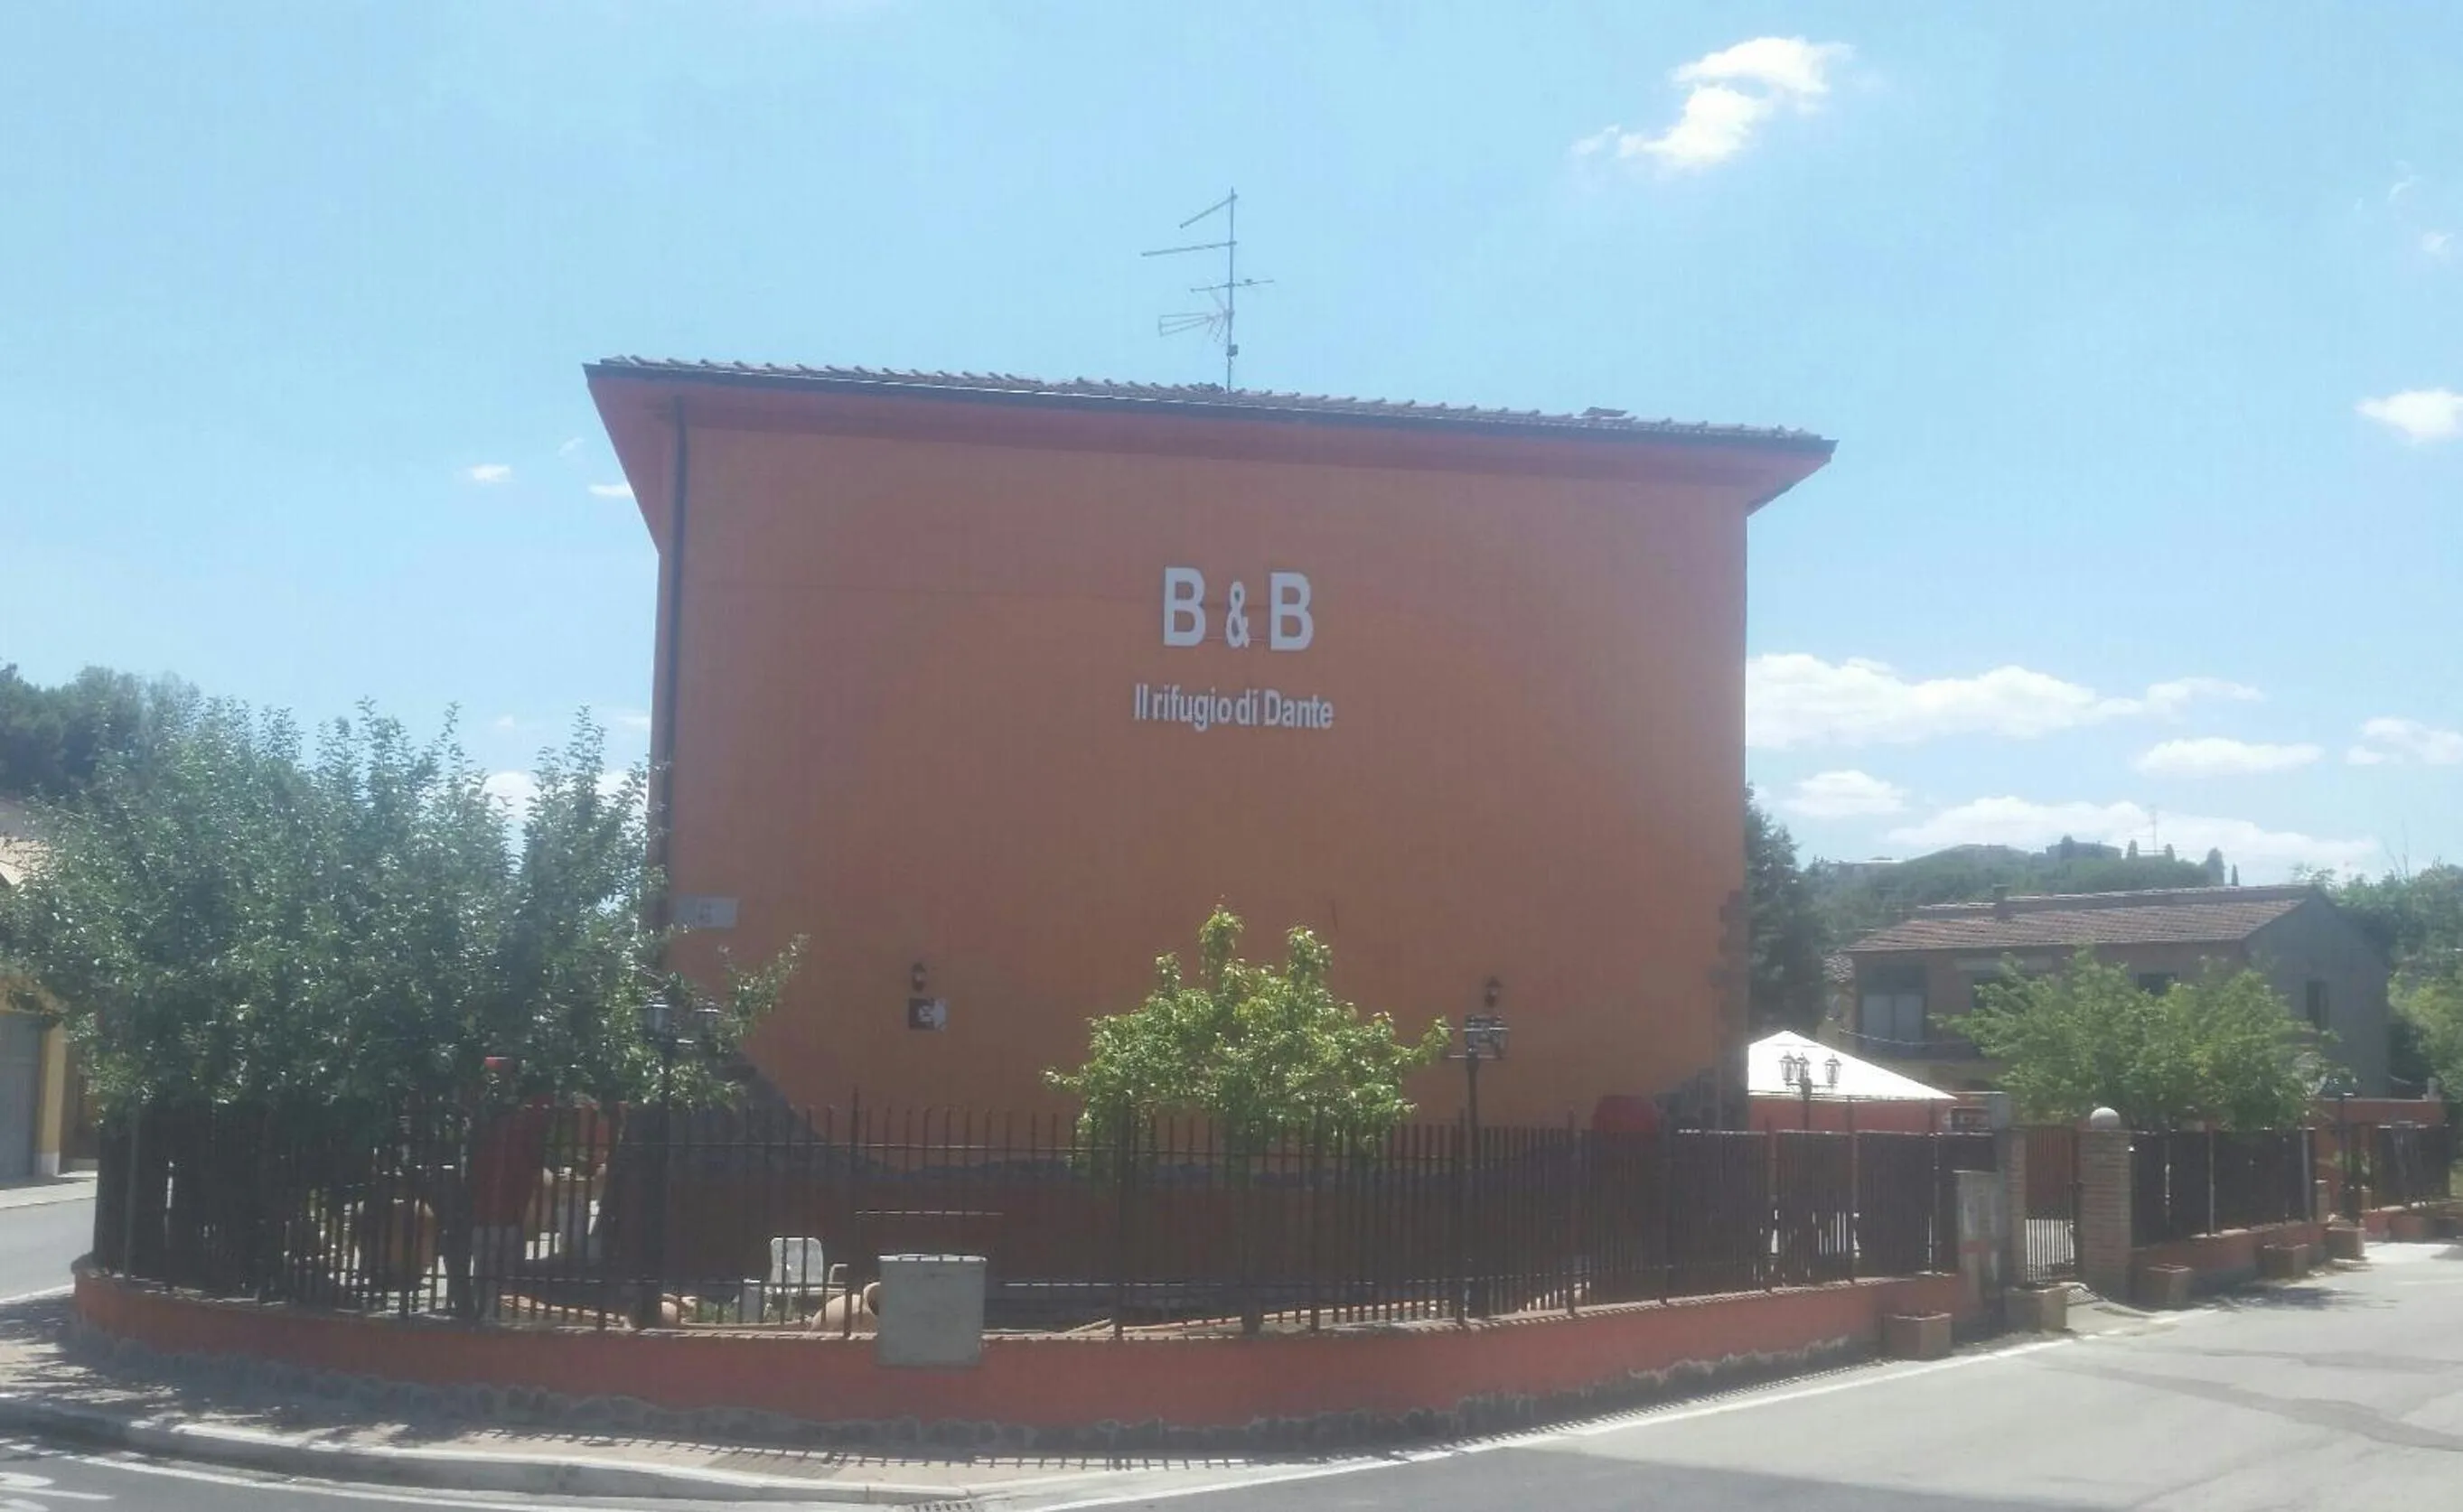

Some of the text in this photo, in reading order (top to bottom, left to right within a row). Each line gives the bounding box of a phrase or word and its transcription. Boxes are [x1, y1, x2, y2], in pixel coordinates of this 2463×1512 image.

[1164, 566, 1314, 650] B & B
[1134, 683, 1334, 733] Il rifugio di Dante
